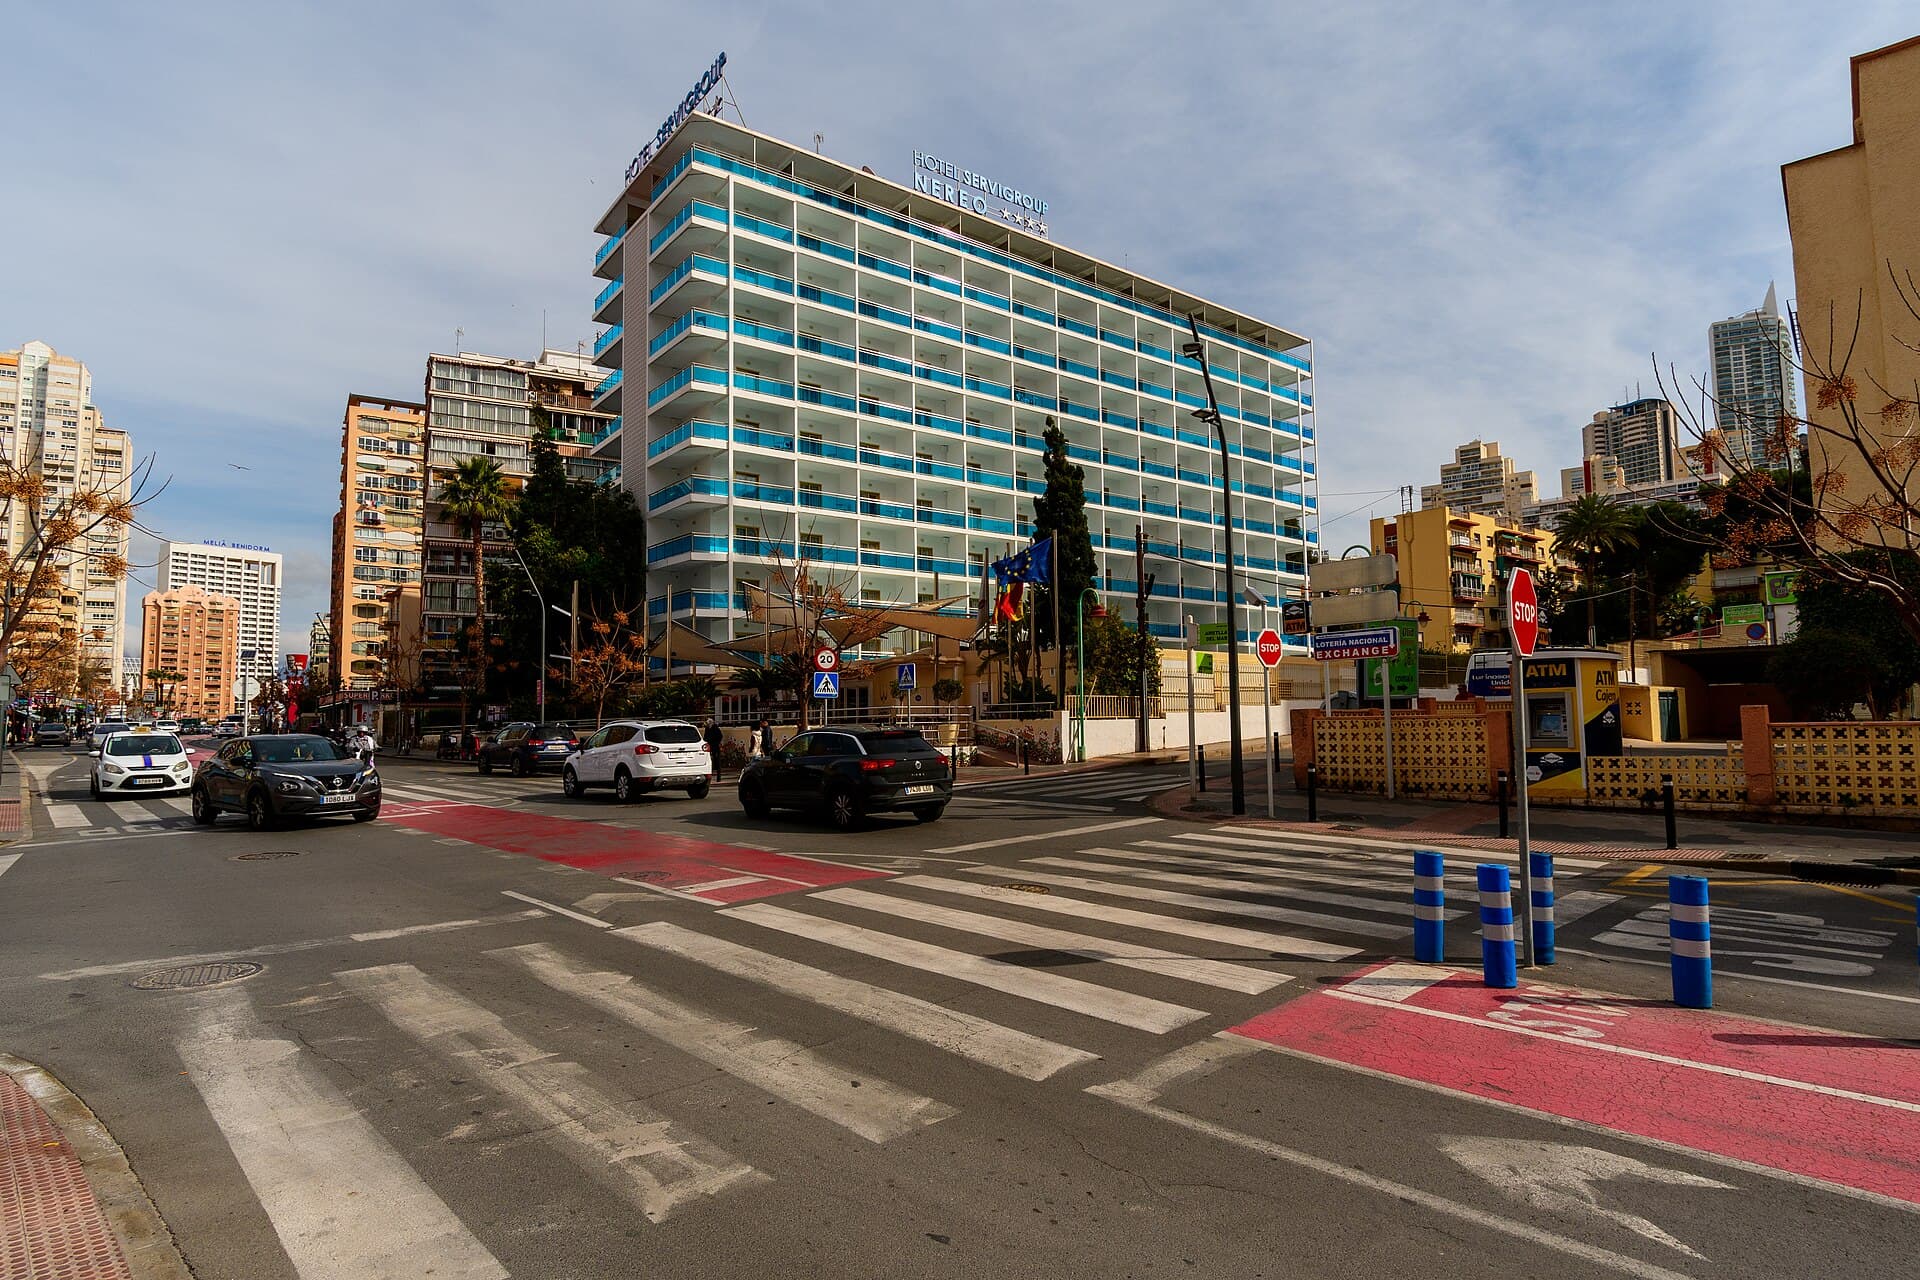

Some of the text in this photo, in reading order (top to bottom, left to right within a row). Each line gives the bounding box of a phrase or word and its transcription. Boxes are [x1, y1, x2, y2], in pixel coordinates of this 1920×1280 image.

[913, 150, 1049, 215] HOTEL SERVIGROUP
[914, 172, 987, 216] NEREO
[231, 543, 271, 552] BENIDORM
[1515, 600, 1536, 623] STOP
[1286, 621, 1306, 633] ATM
[1260, 643, 1280, 653] STOP
[1349, 637, 1389, 647] NACIONAL
[1316, 646, 1390, 659] EXCHANGE
[820, 655, 833, 664] 20
[1526, 663, 1568, 678] ATM
[1596, 671, 1616, 685] ATM
